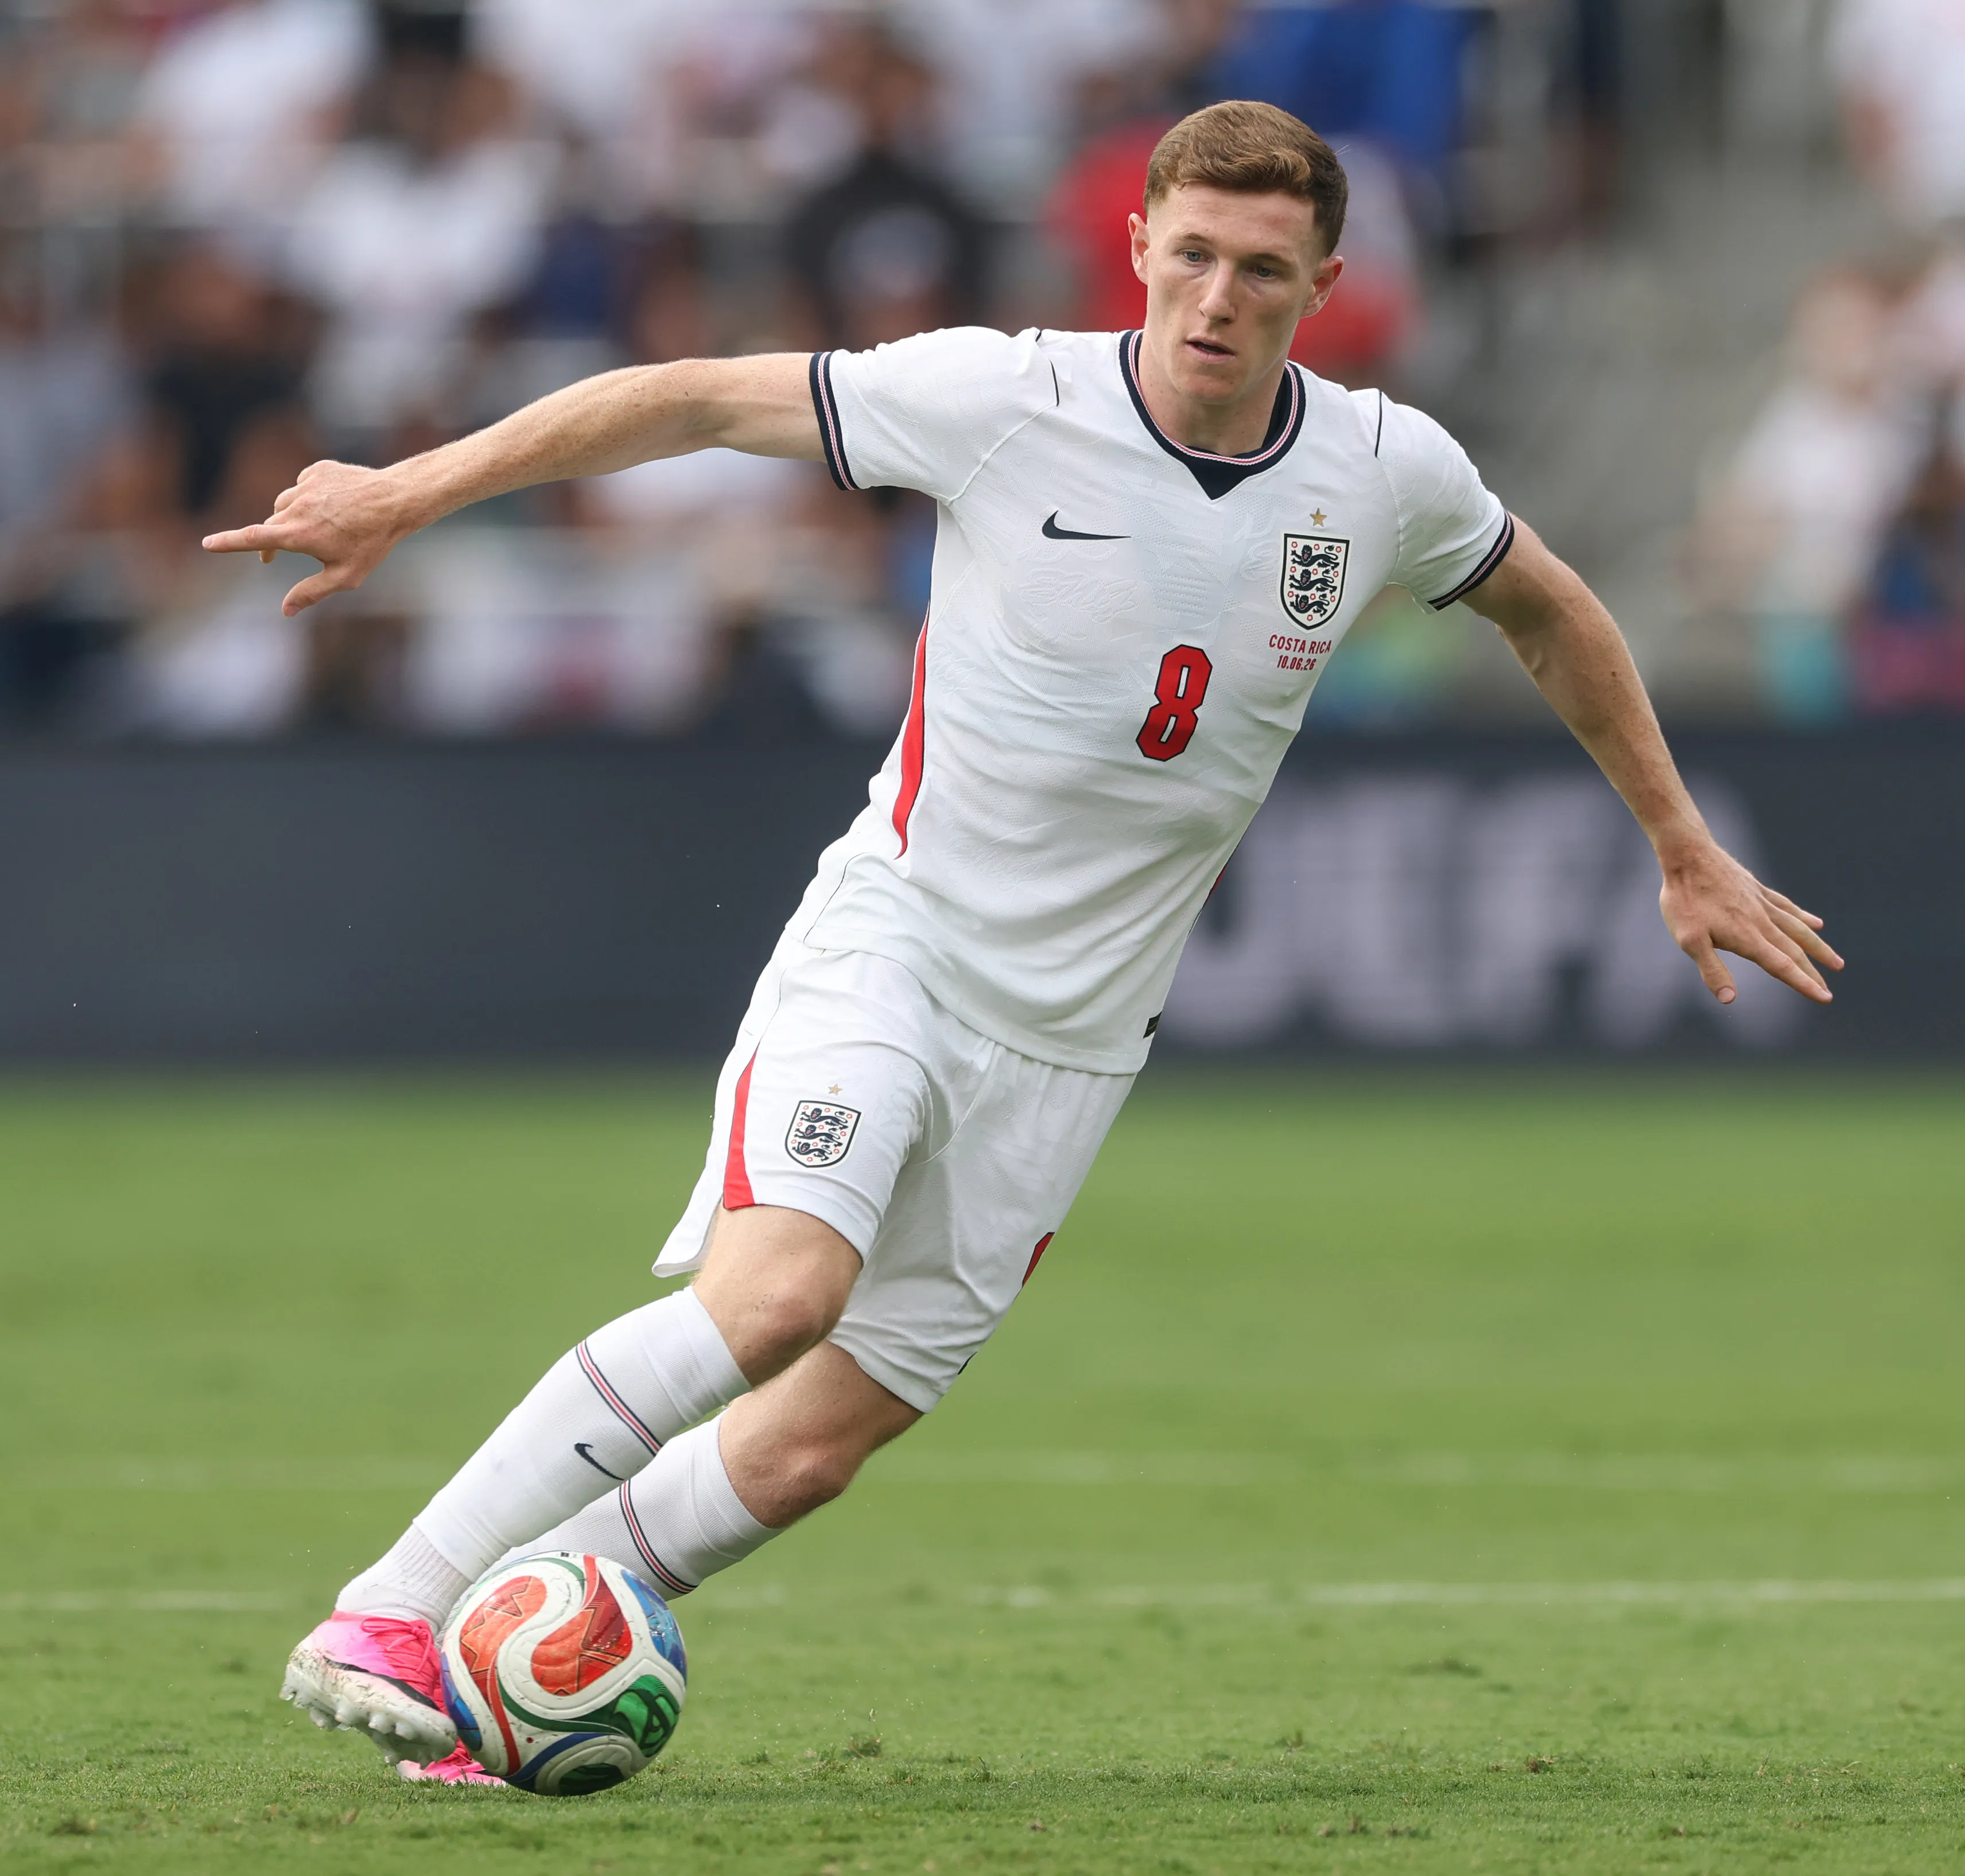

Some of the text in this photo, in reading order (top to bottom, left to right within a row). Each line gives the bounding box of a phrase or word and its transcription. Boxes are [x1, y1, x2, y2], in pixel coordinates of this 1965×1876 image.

[1269, 634, 1331, 654] COSTA RICA
[1277, 655, 1317, 670] 10.06.26
[1135, 644, 1213, 762] 8
